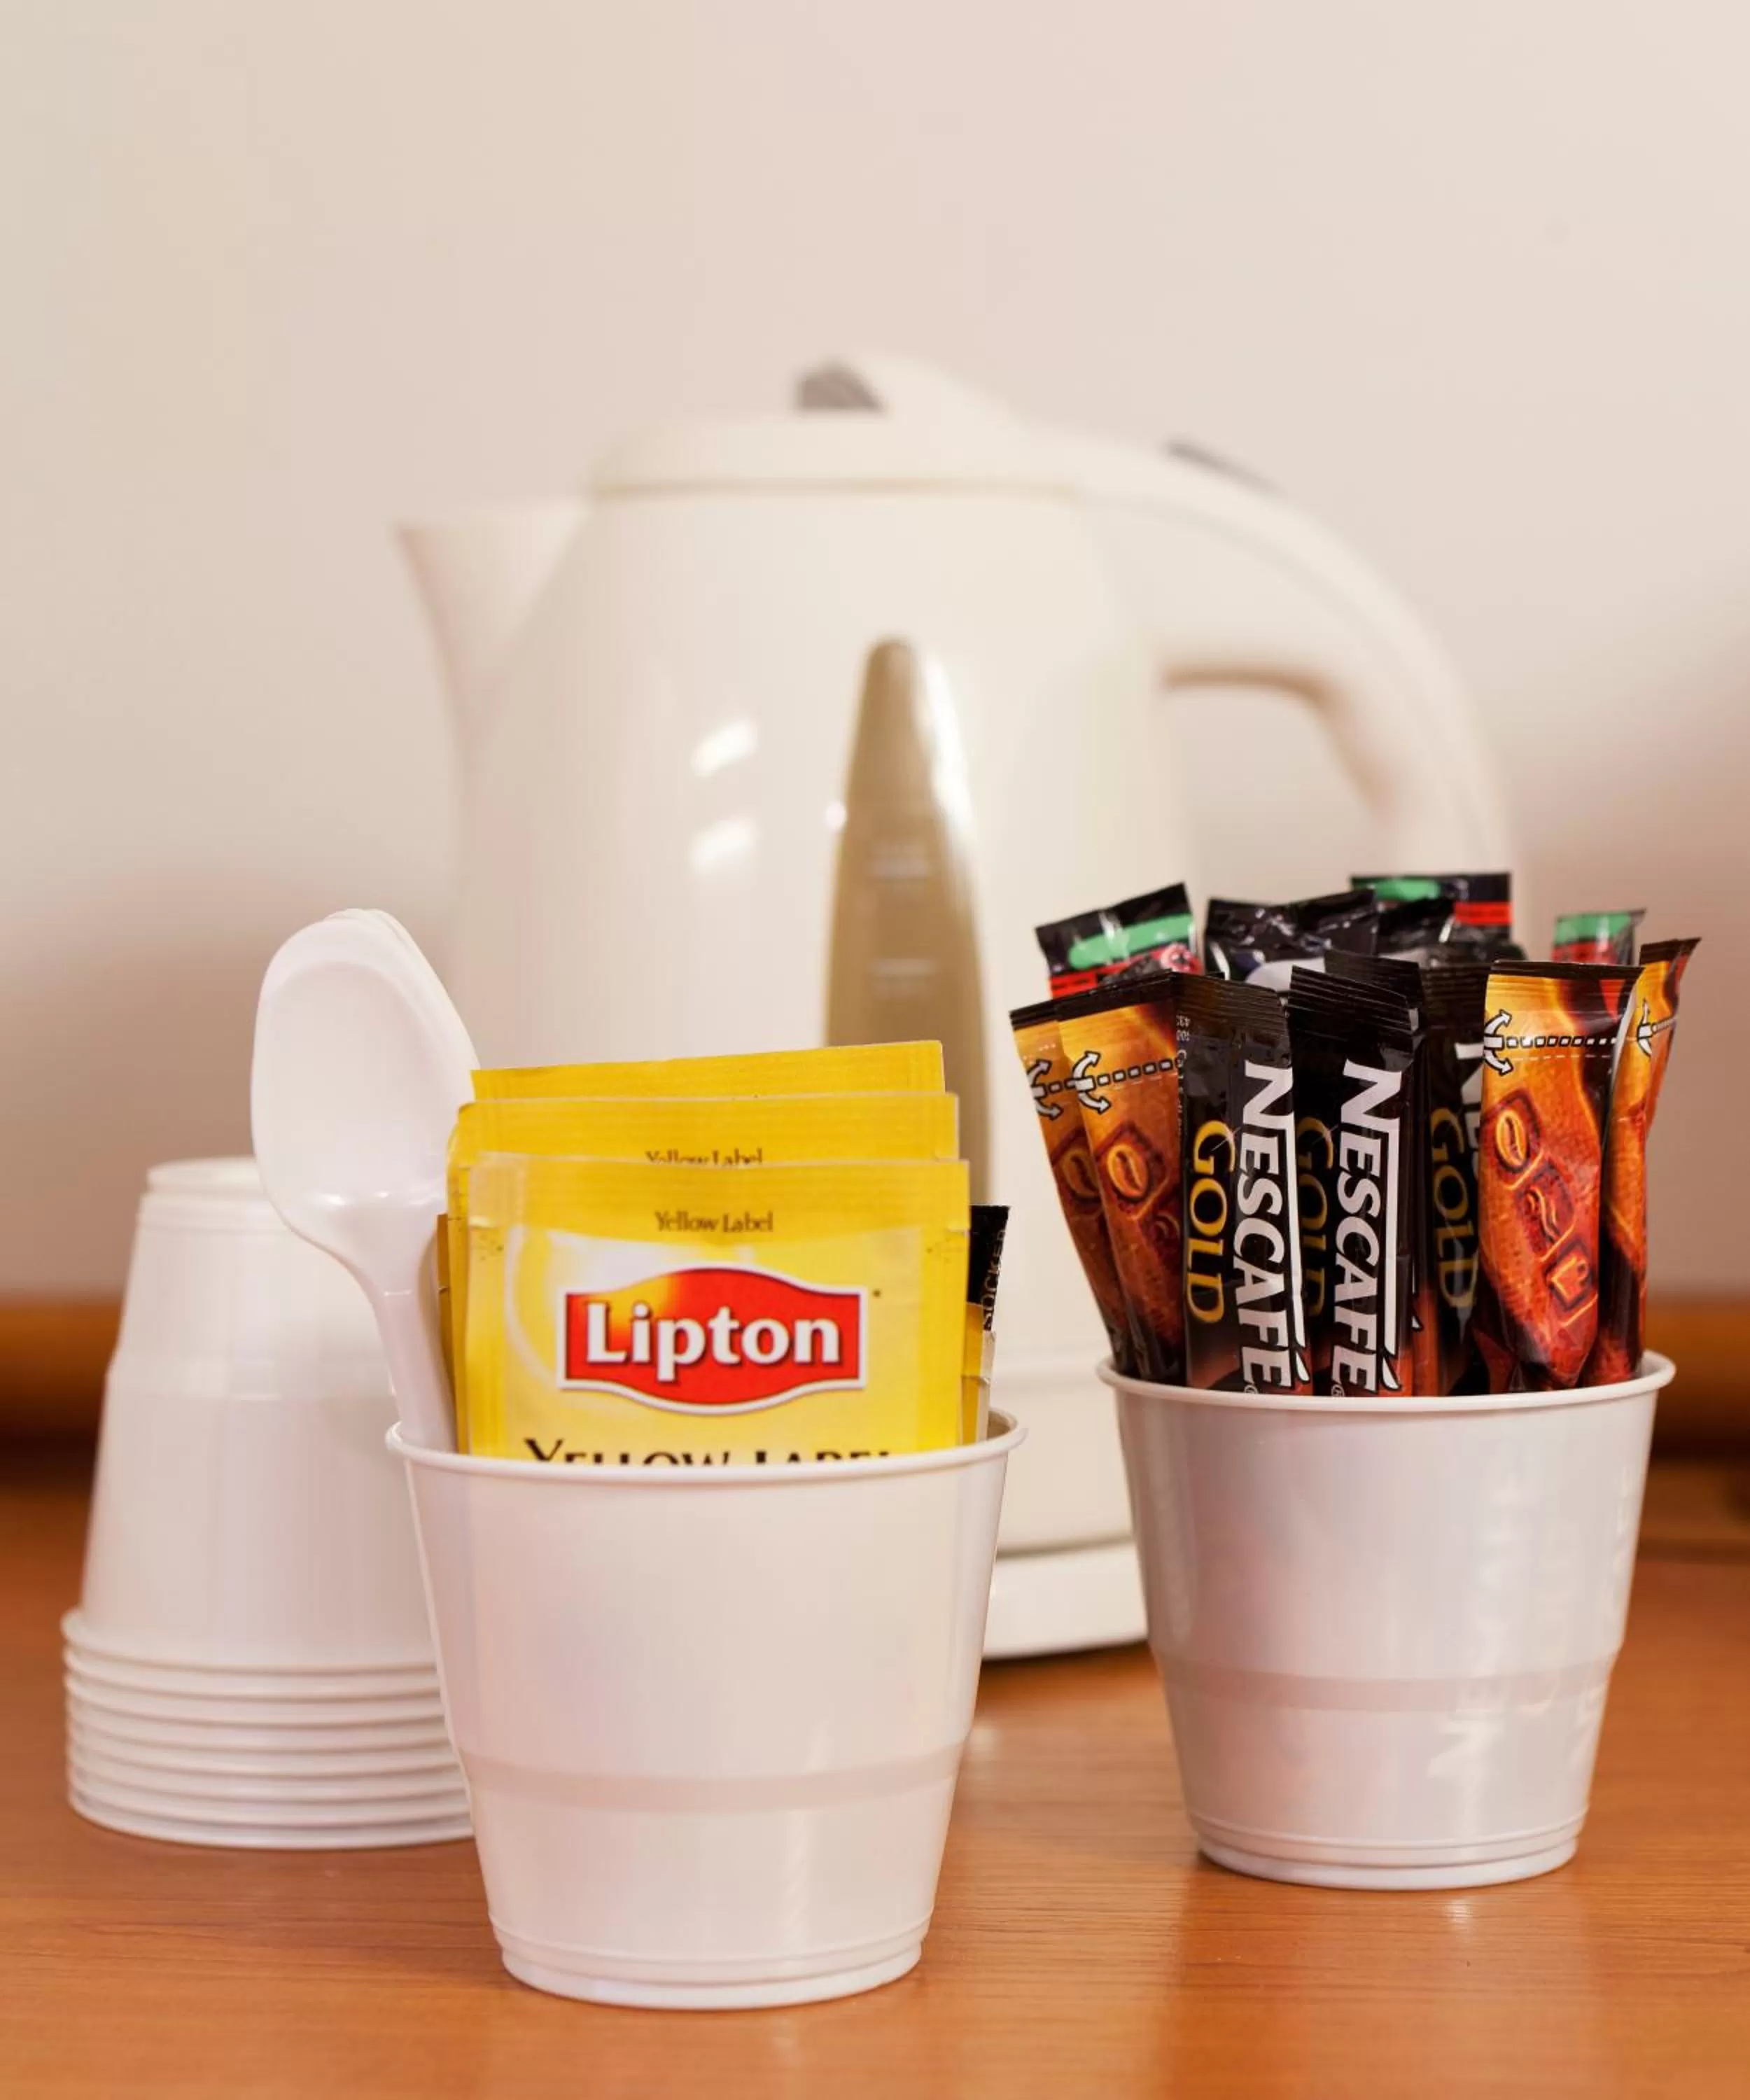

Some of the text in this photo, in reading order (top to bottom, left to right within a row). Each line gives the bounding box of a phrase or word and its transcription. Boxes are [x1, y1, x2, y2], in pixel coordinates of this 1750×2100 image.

[654, 1210, 774, 1233] Yellow Label
[1186, 1120, 1236, 1322] GOLD
[1430, 1107, 1478, 1308] GOLD
[586, 1301, 841, 1383] Lipton
